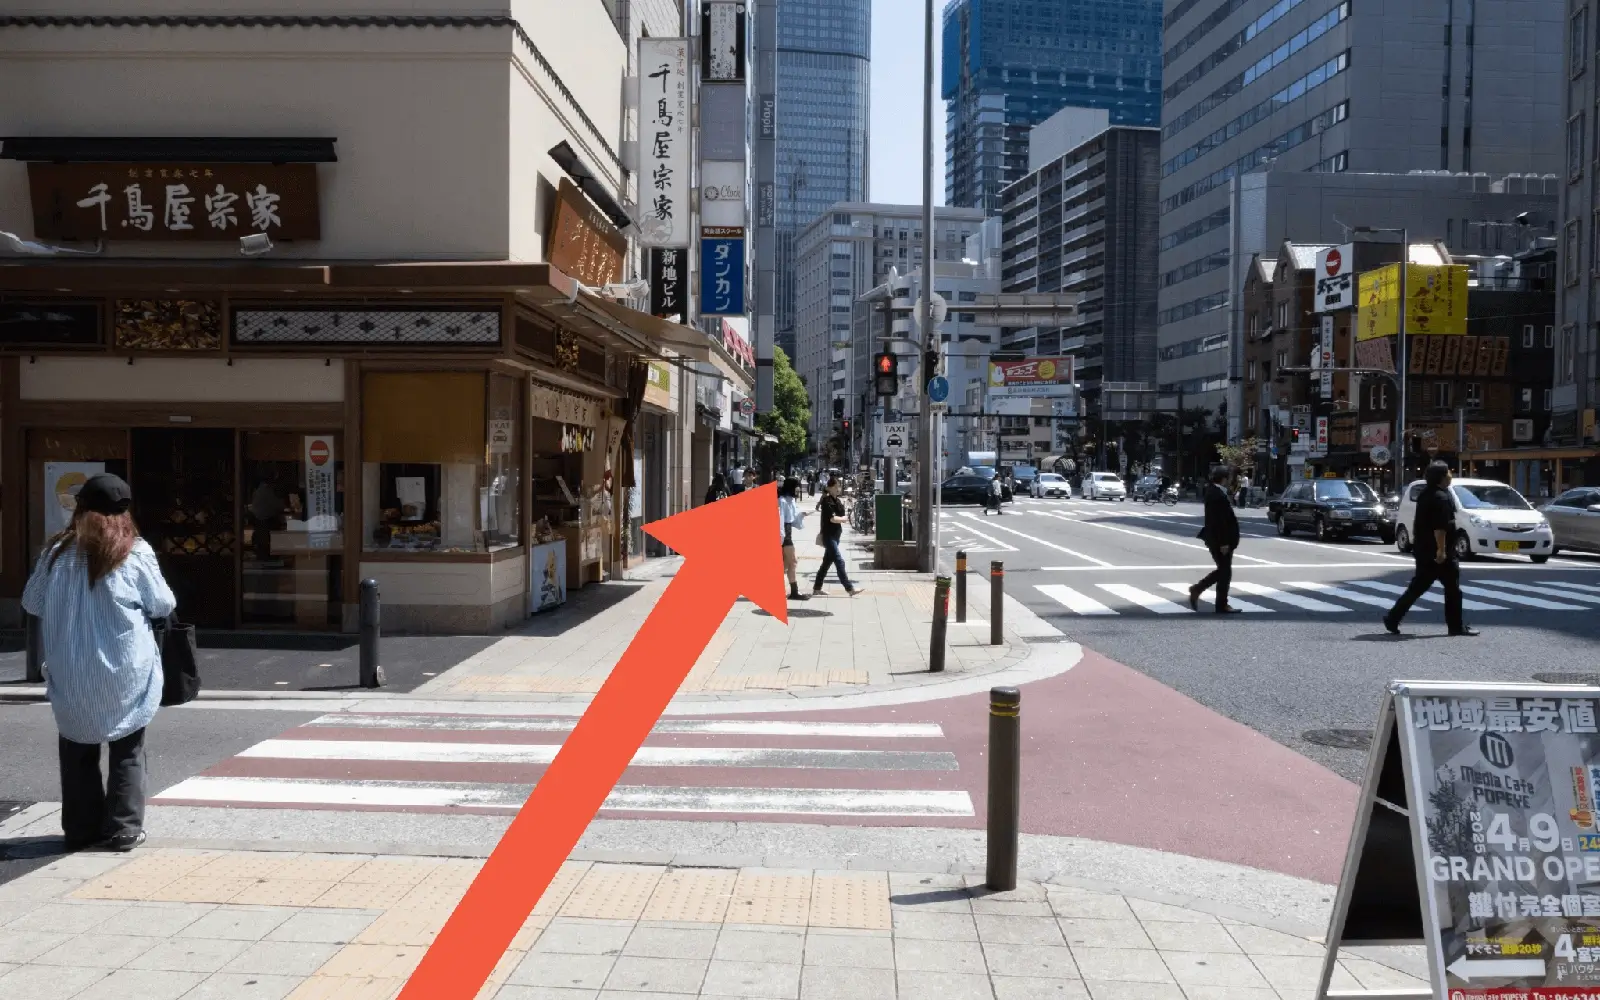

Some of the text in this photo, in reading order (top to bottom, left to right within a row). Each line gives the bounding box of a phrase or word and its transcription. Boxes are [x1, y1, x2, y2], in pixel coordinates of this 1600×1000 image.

[761, 100, 774, 135] Propia
[648, 63, 674, 221] 千鳥屋宗家
[76, 182, 282, 232] 千鳥屋宗家
[661, 249, 678, 308] 新地ビル
[714, 243, 732, 312] ダンカン
[884, 425, 905, 433] TAXI
[1414, 697, 1599, 734] 地域最安値
[1469, 811, 1486, 854] 2025
[1430, 856, 1536, 882] GRAND
